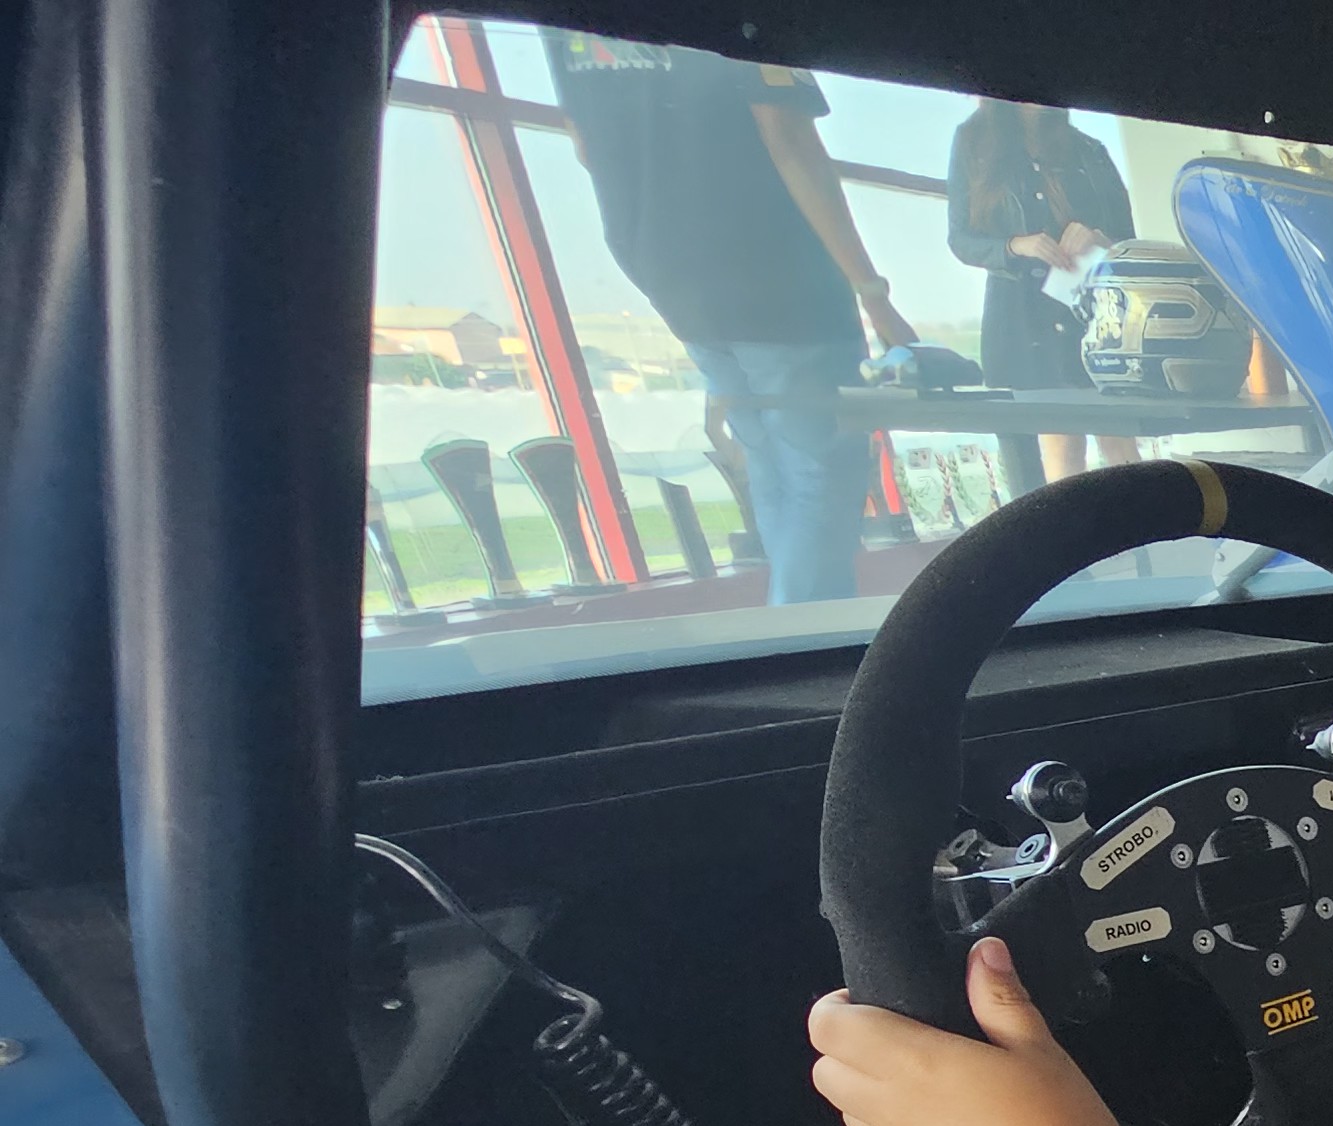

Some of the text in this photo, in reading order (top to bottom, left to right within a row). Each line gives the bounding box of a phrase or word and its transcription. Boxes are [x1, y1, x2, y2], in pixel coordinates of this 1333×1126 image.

[1098, 825, 1154, 873] STROBO
[1105, 919, 1152, 940] RADIO
[1262, 995, 1317, 1030] OMP
